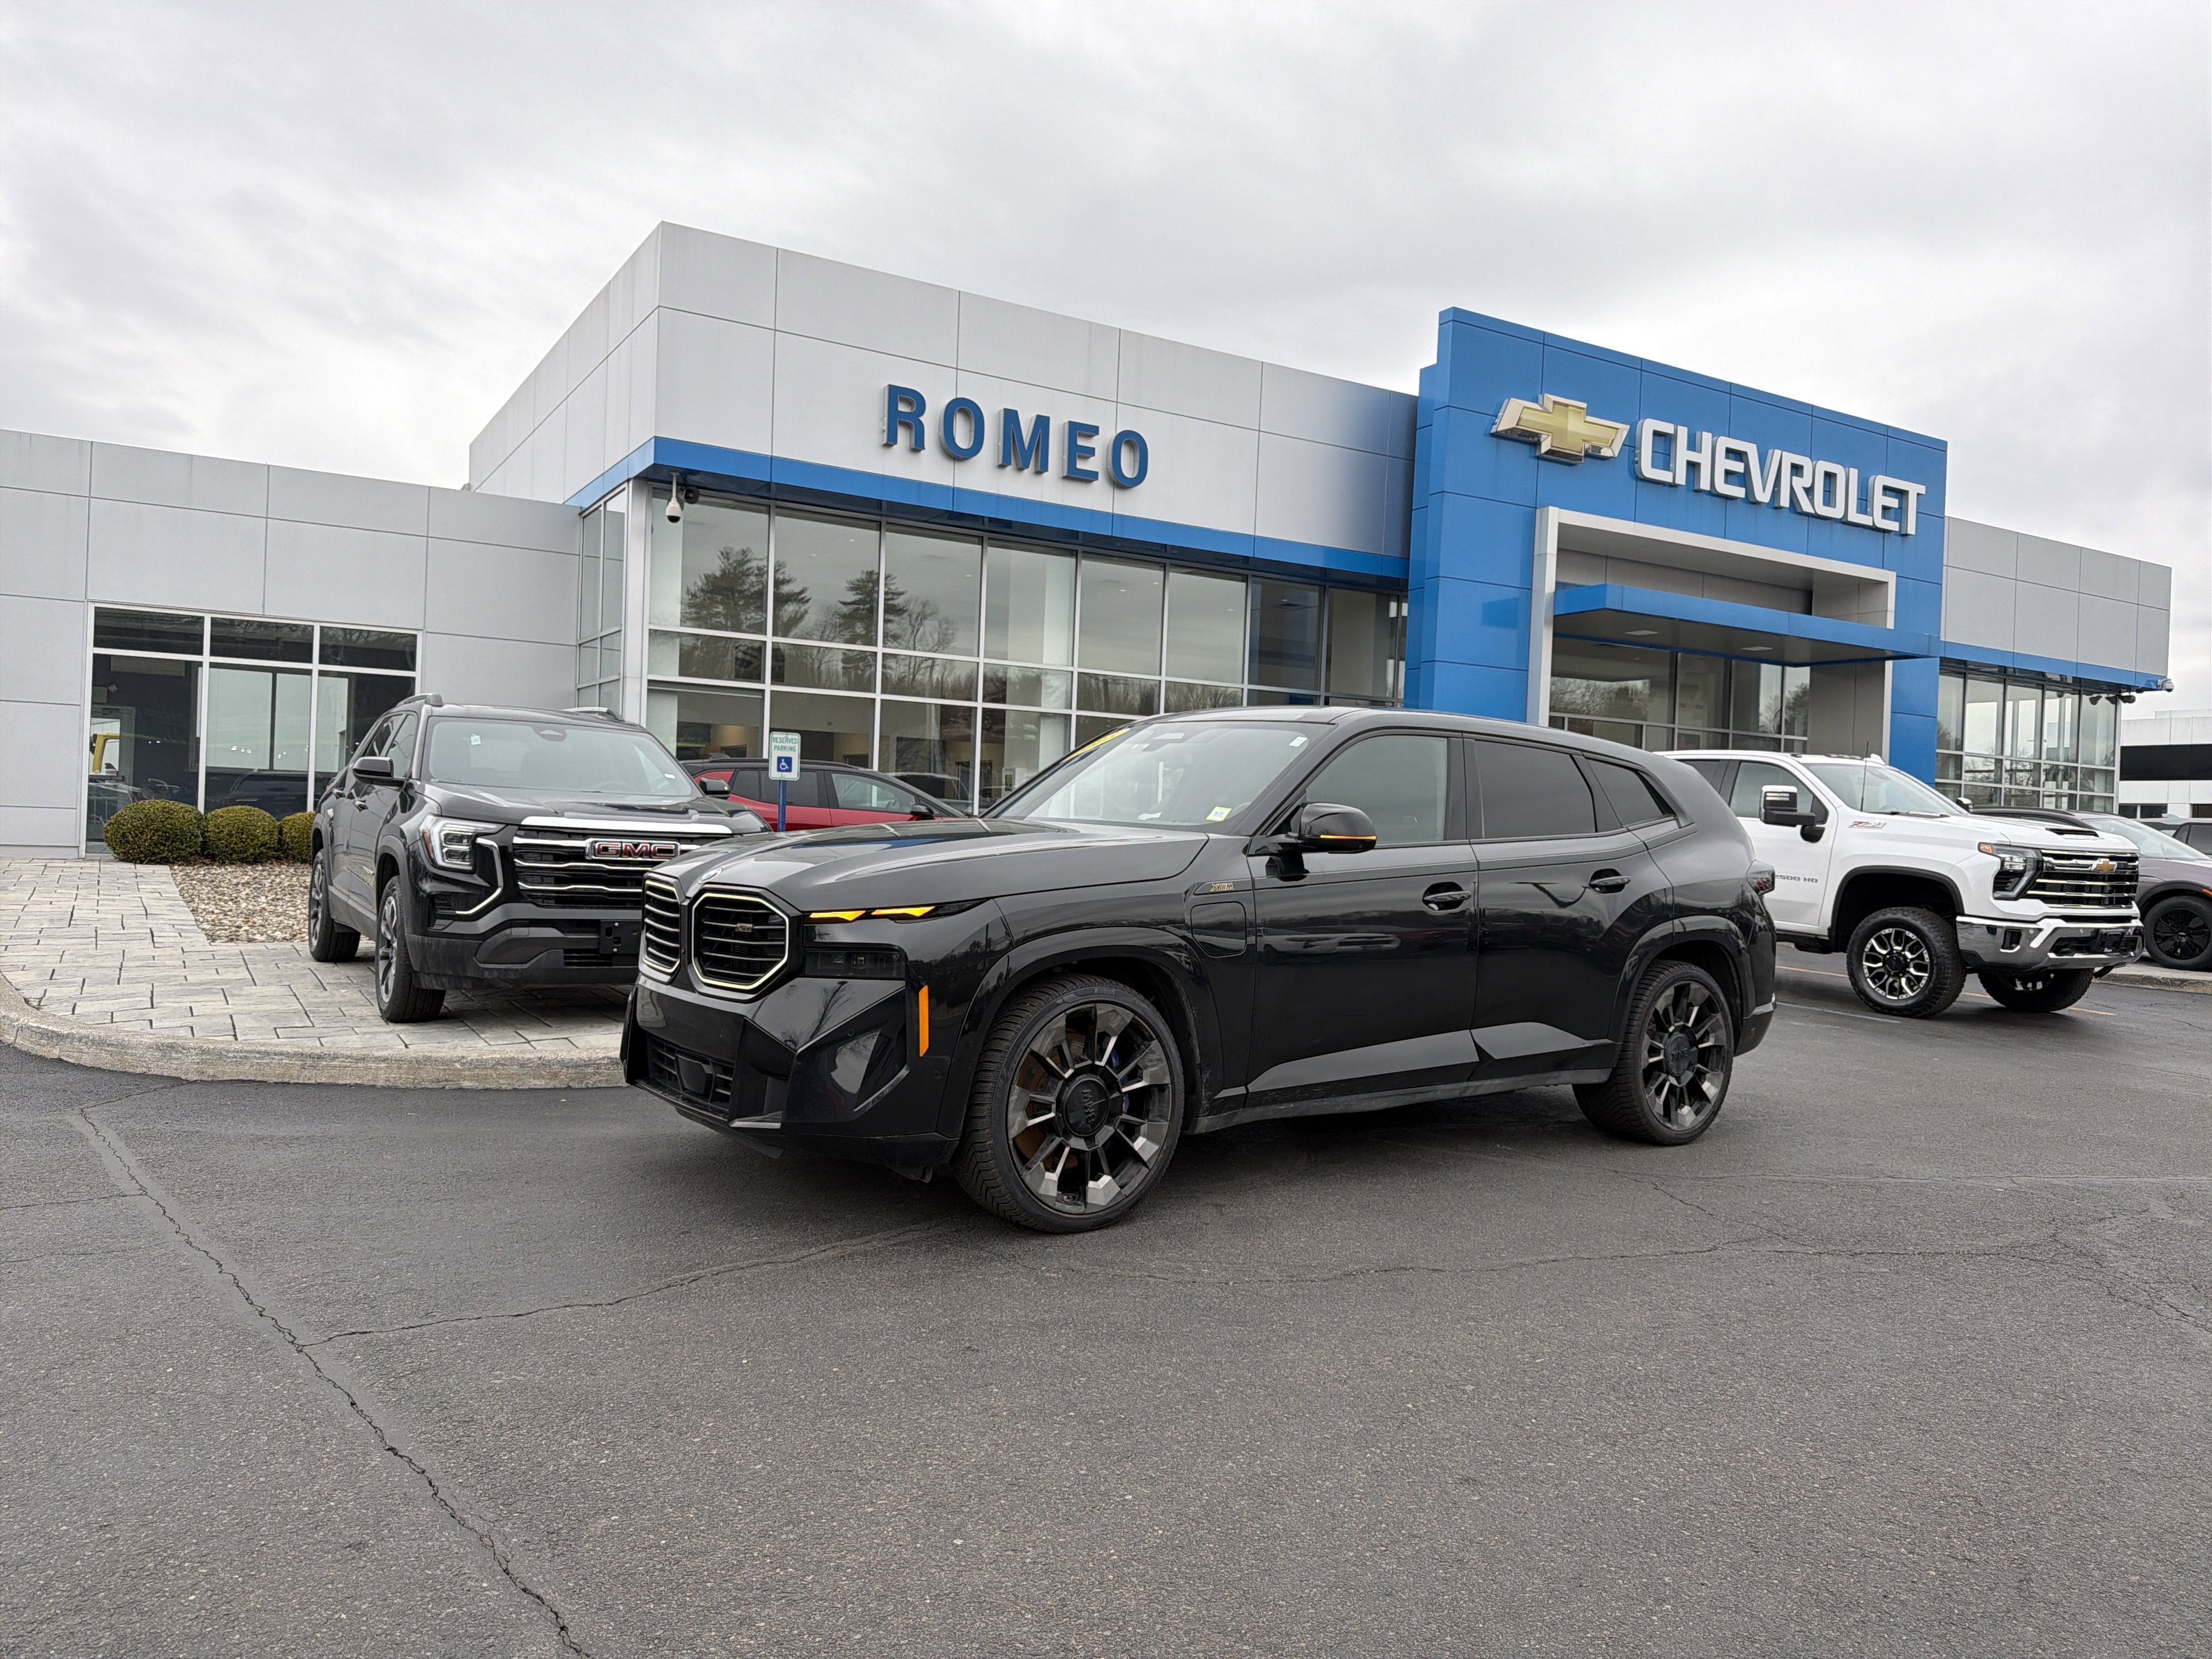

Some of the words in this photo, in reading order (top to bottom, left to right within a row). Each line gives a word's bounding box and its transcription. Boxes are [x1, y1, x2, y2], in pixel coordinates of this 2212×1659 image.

[883, 383, 1149, 489] ROMEO
[1634, 418, 1927, 536] CHEVROLET
[595, 842, 675, 859] GMC
